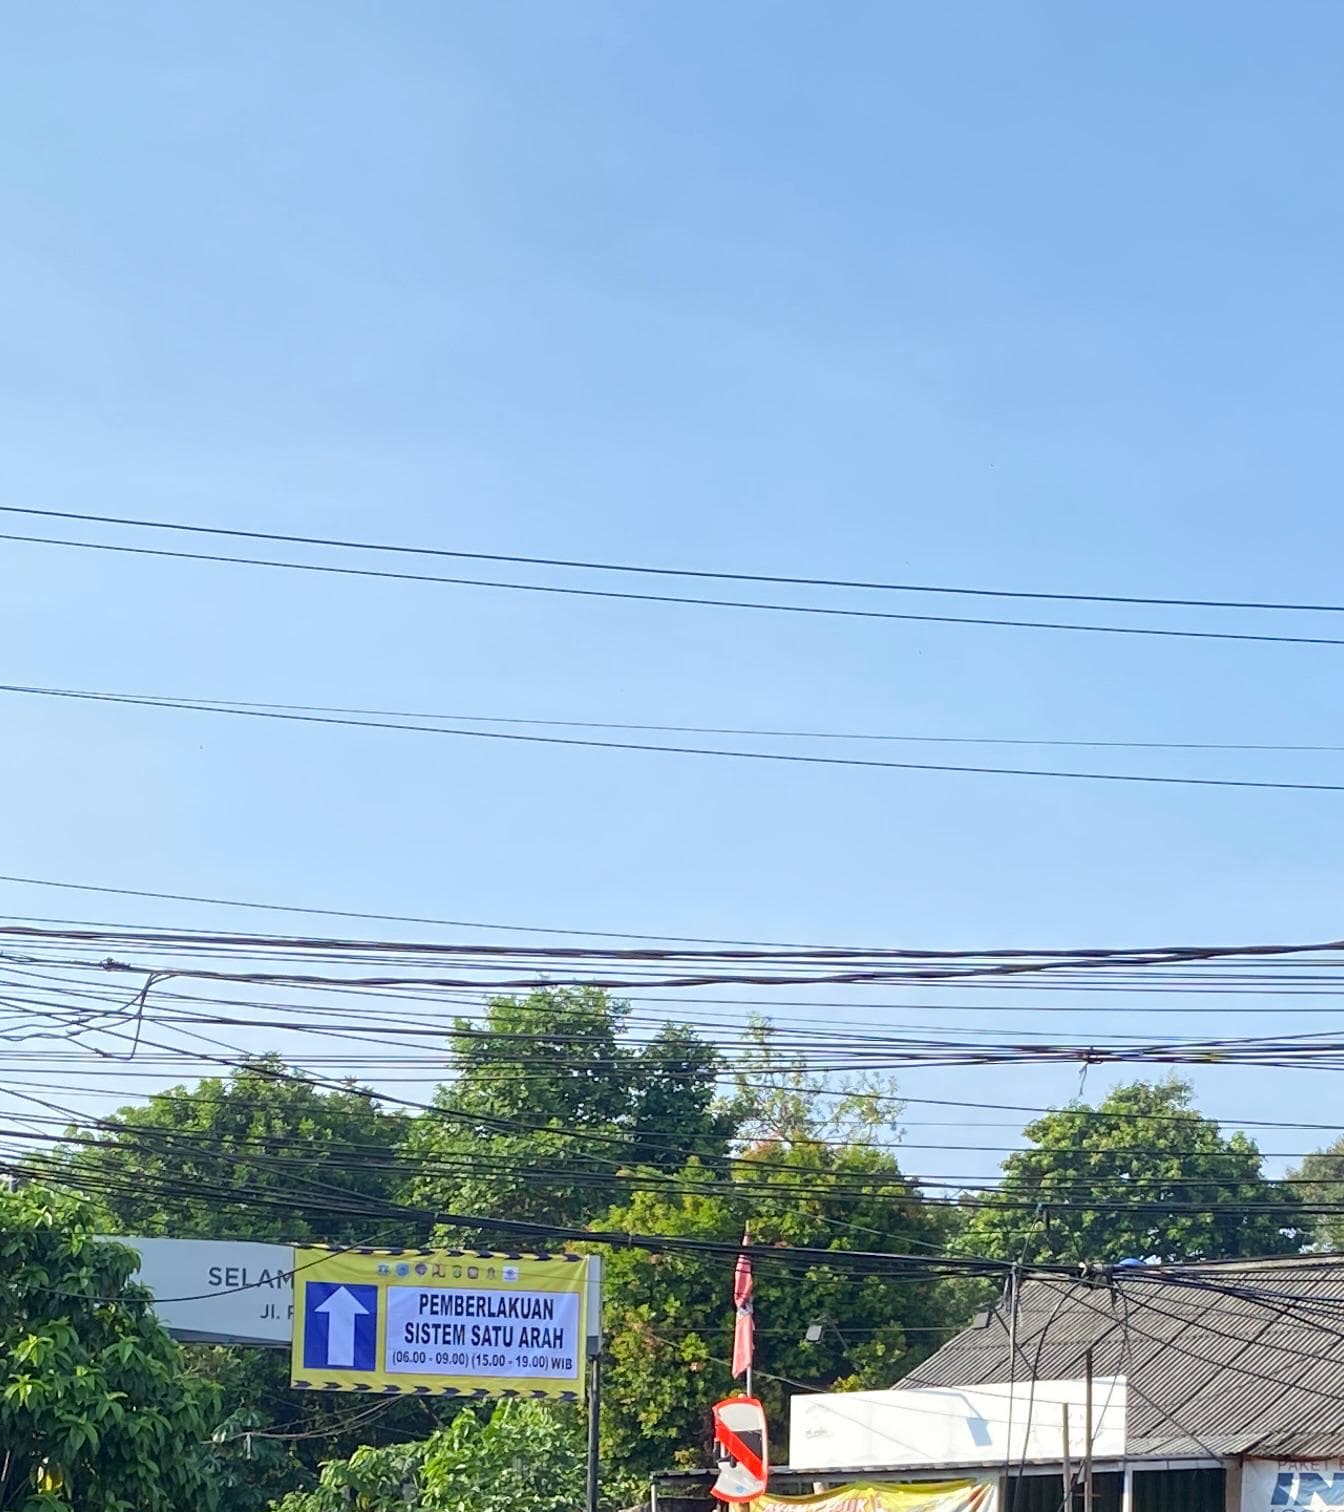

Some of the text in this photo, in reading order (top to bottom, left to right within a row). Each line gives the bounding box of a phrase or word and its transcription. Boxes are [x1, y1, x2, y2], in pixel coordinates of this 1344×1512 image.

[419, 1293, 554, 1320] PEMBERLAKUAN
[404, 1322, 564, 1349] SISTEM SATU ARAH
[392, 1351, 426, 1364] (06.00
[435, 1352, 469, 1367] 09.00)
[471, 1354, 505, 1369] (15.00
[515, 1356, 549, 1370] 19.00)
[551, 1357, 573, 1370] WIB
[1278, 1457, 1331, 1471] PAKET
